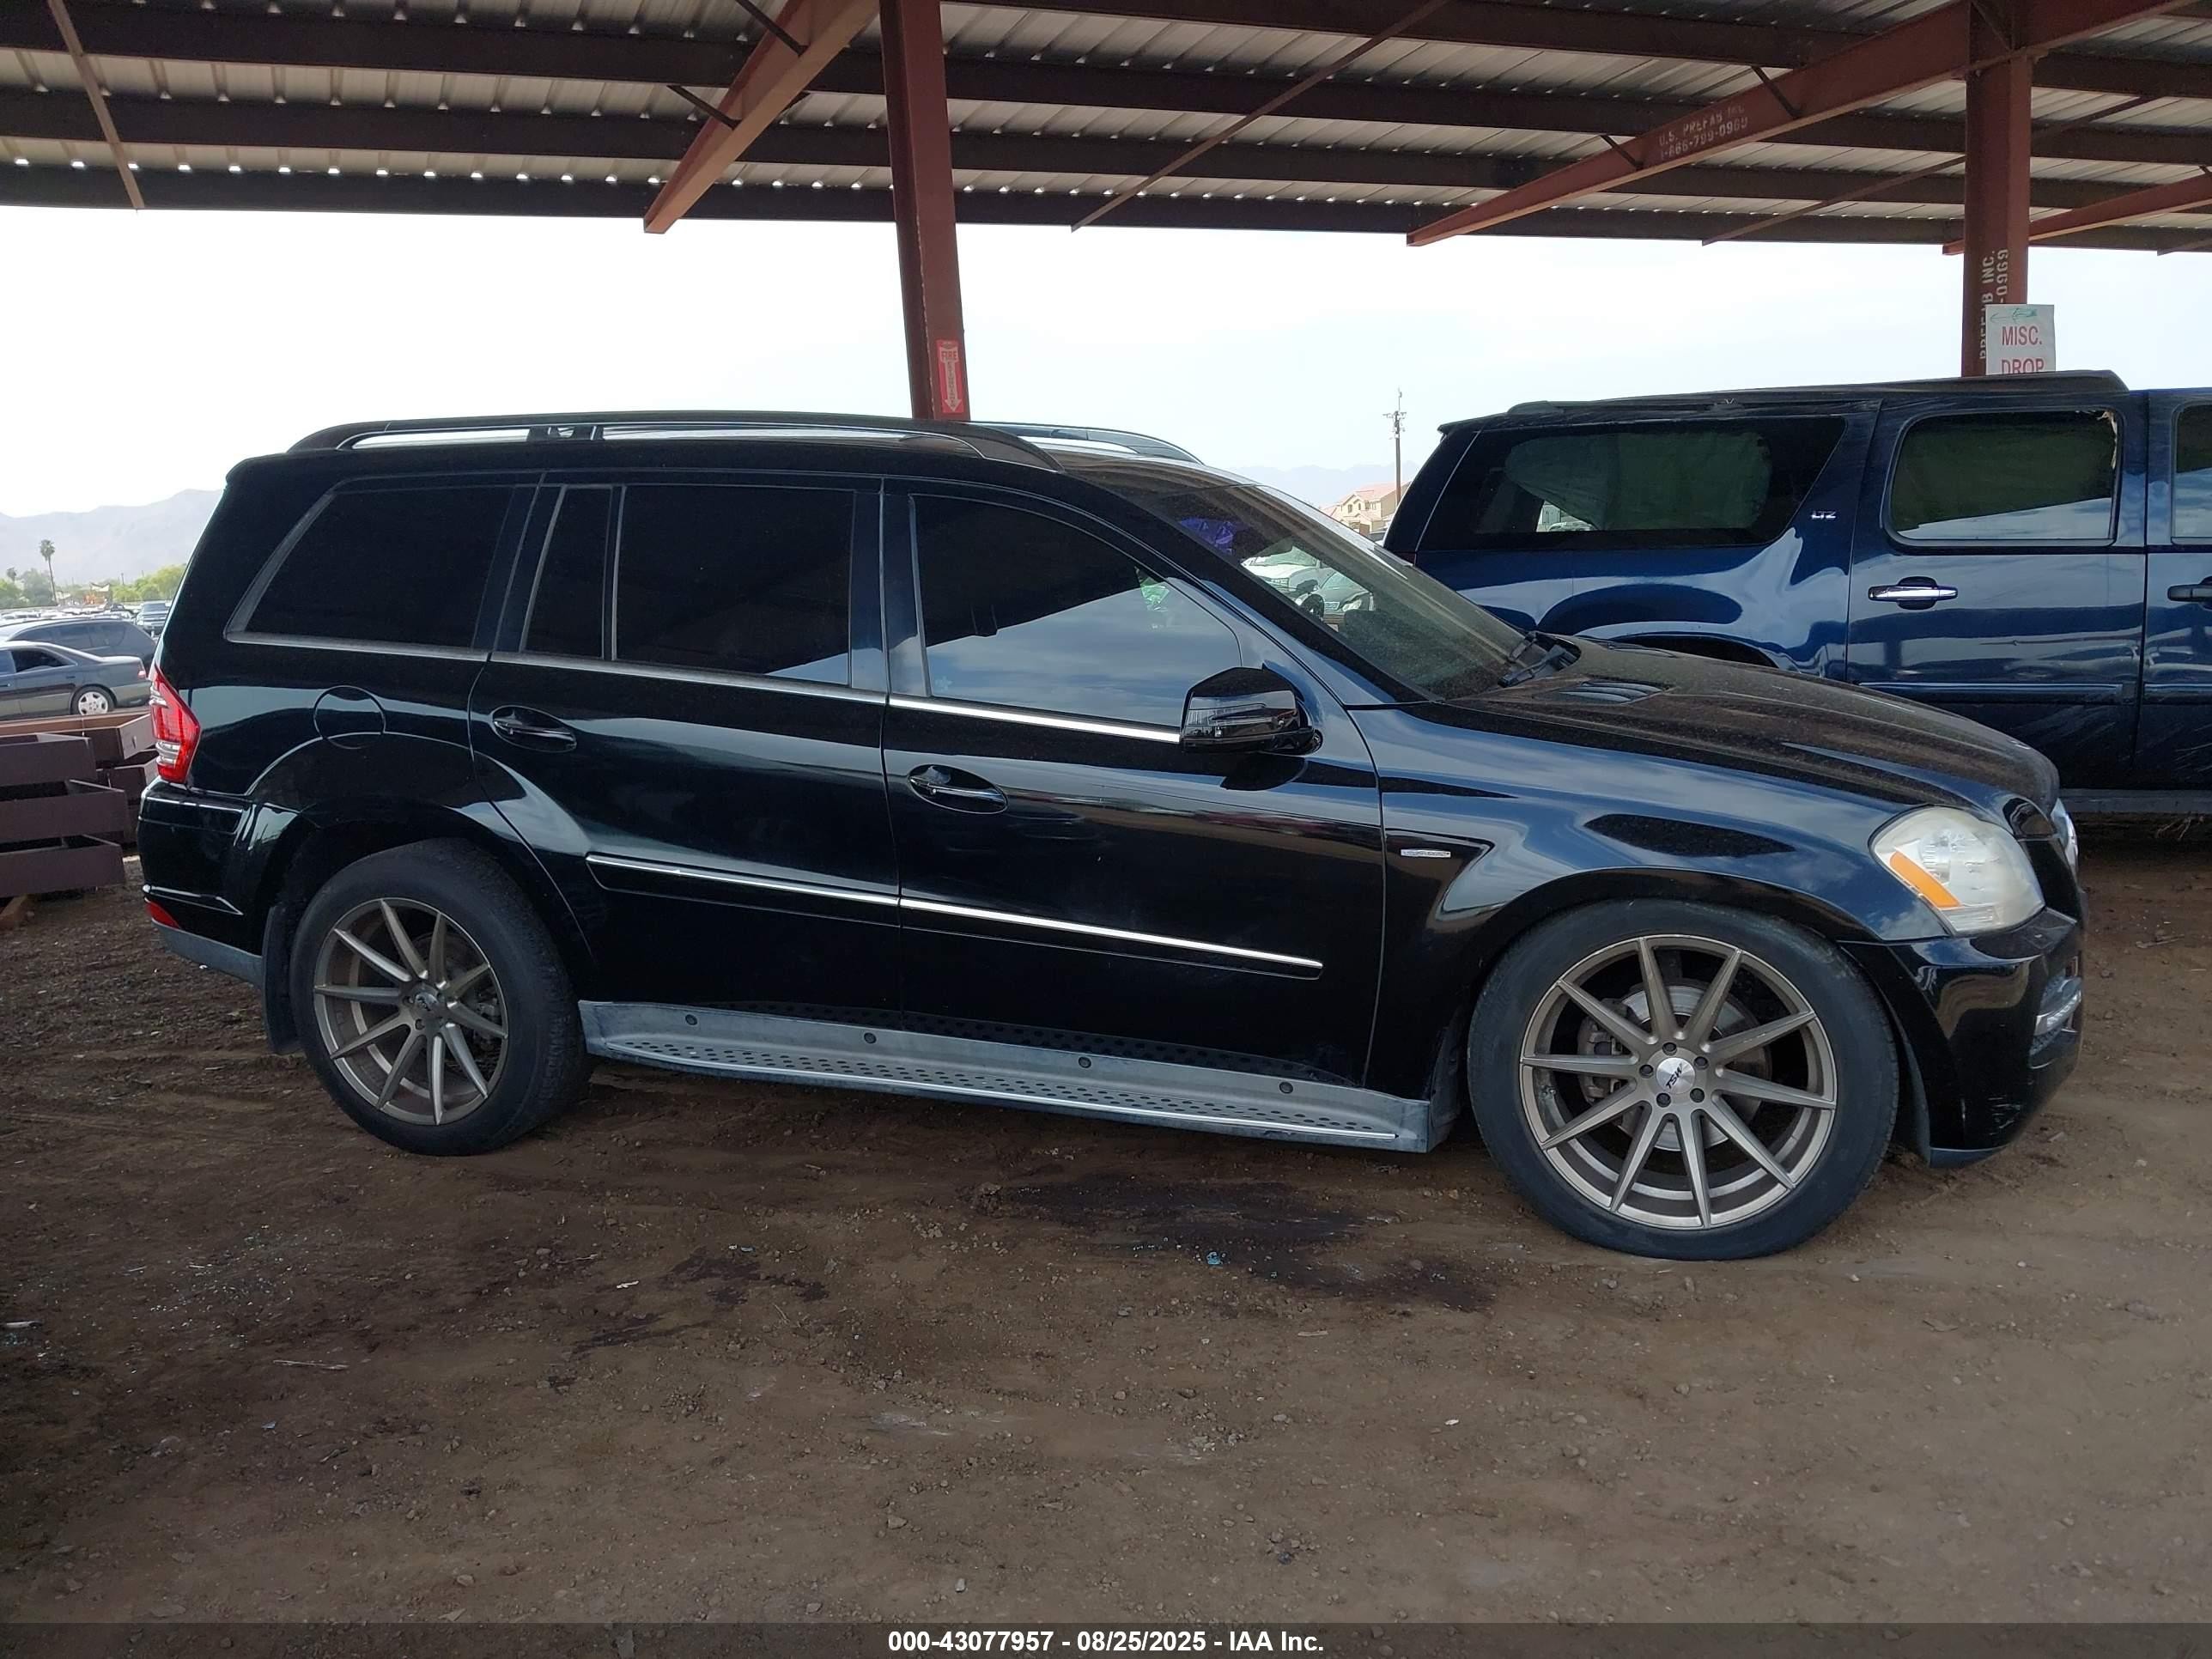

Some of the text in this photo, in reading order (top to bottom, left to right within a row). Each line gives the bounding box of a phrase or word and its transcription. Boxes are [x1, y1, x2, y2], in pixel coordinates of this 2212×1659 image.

[1982, 250, 1995, 284] INC.
[2002, 325, 2043, 345] MISC.
[2001, 358, 2045, 374] DROP
[1812, 510, 1837, 520] LTZ
